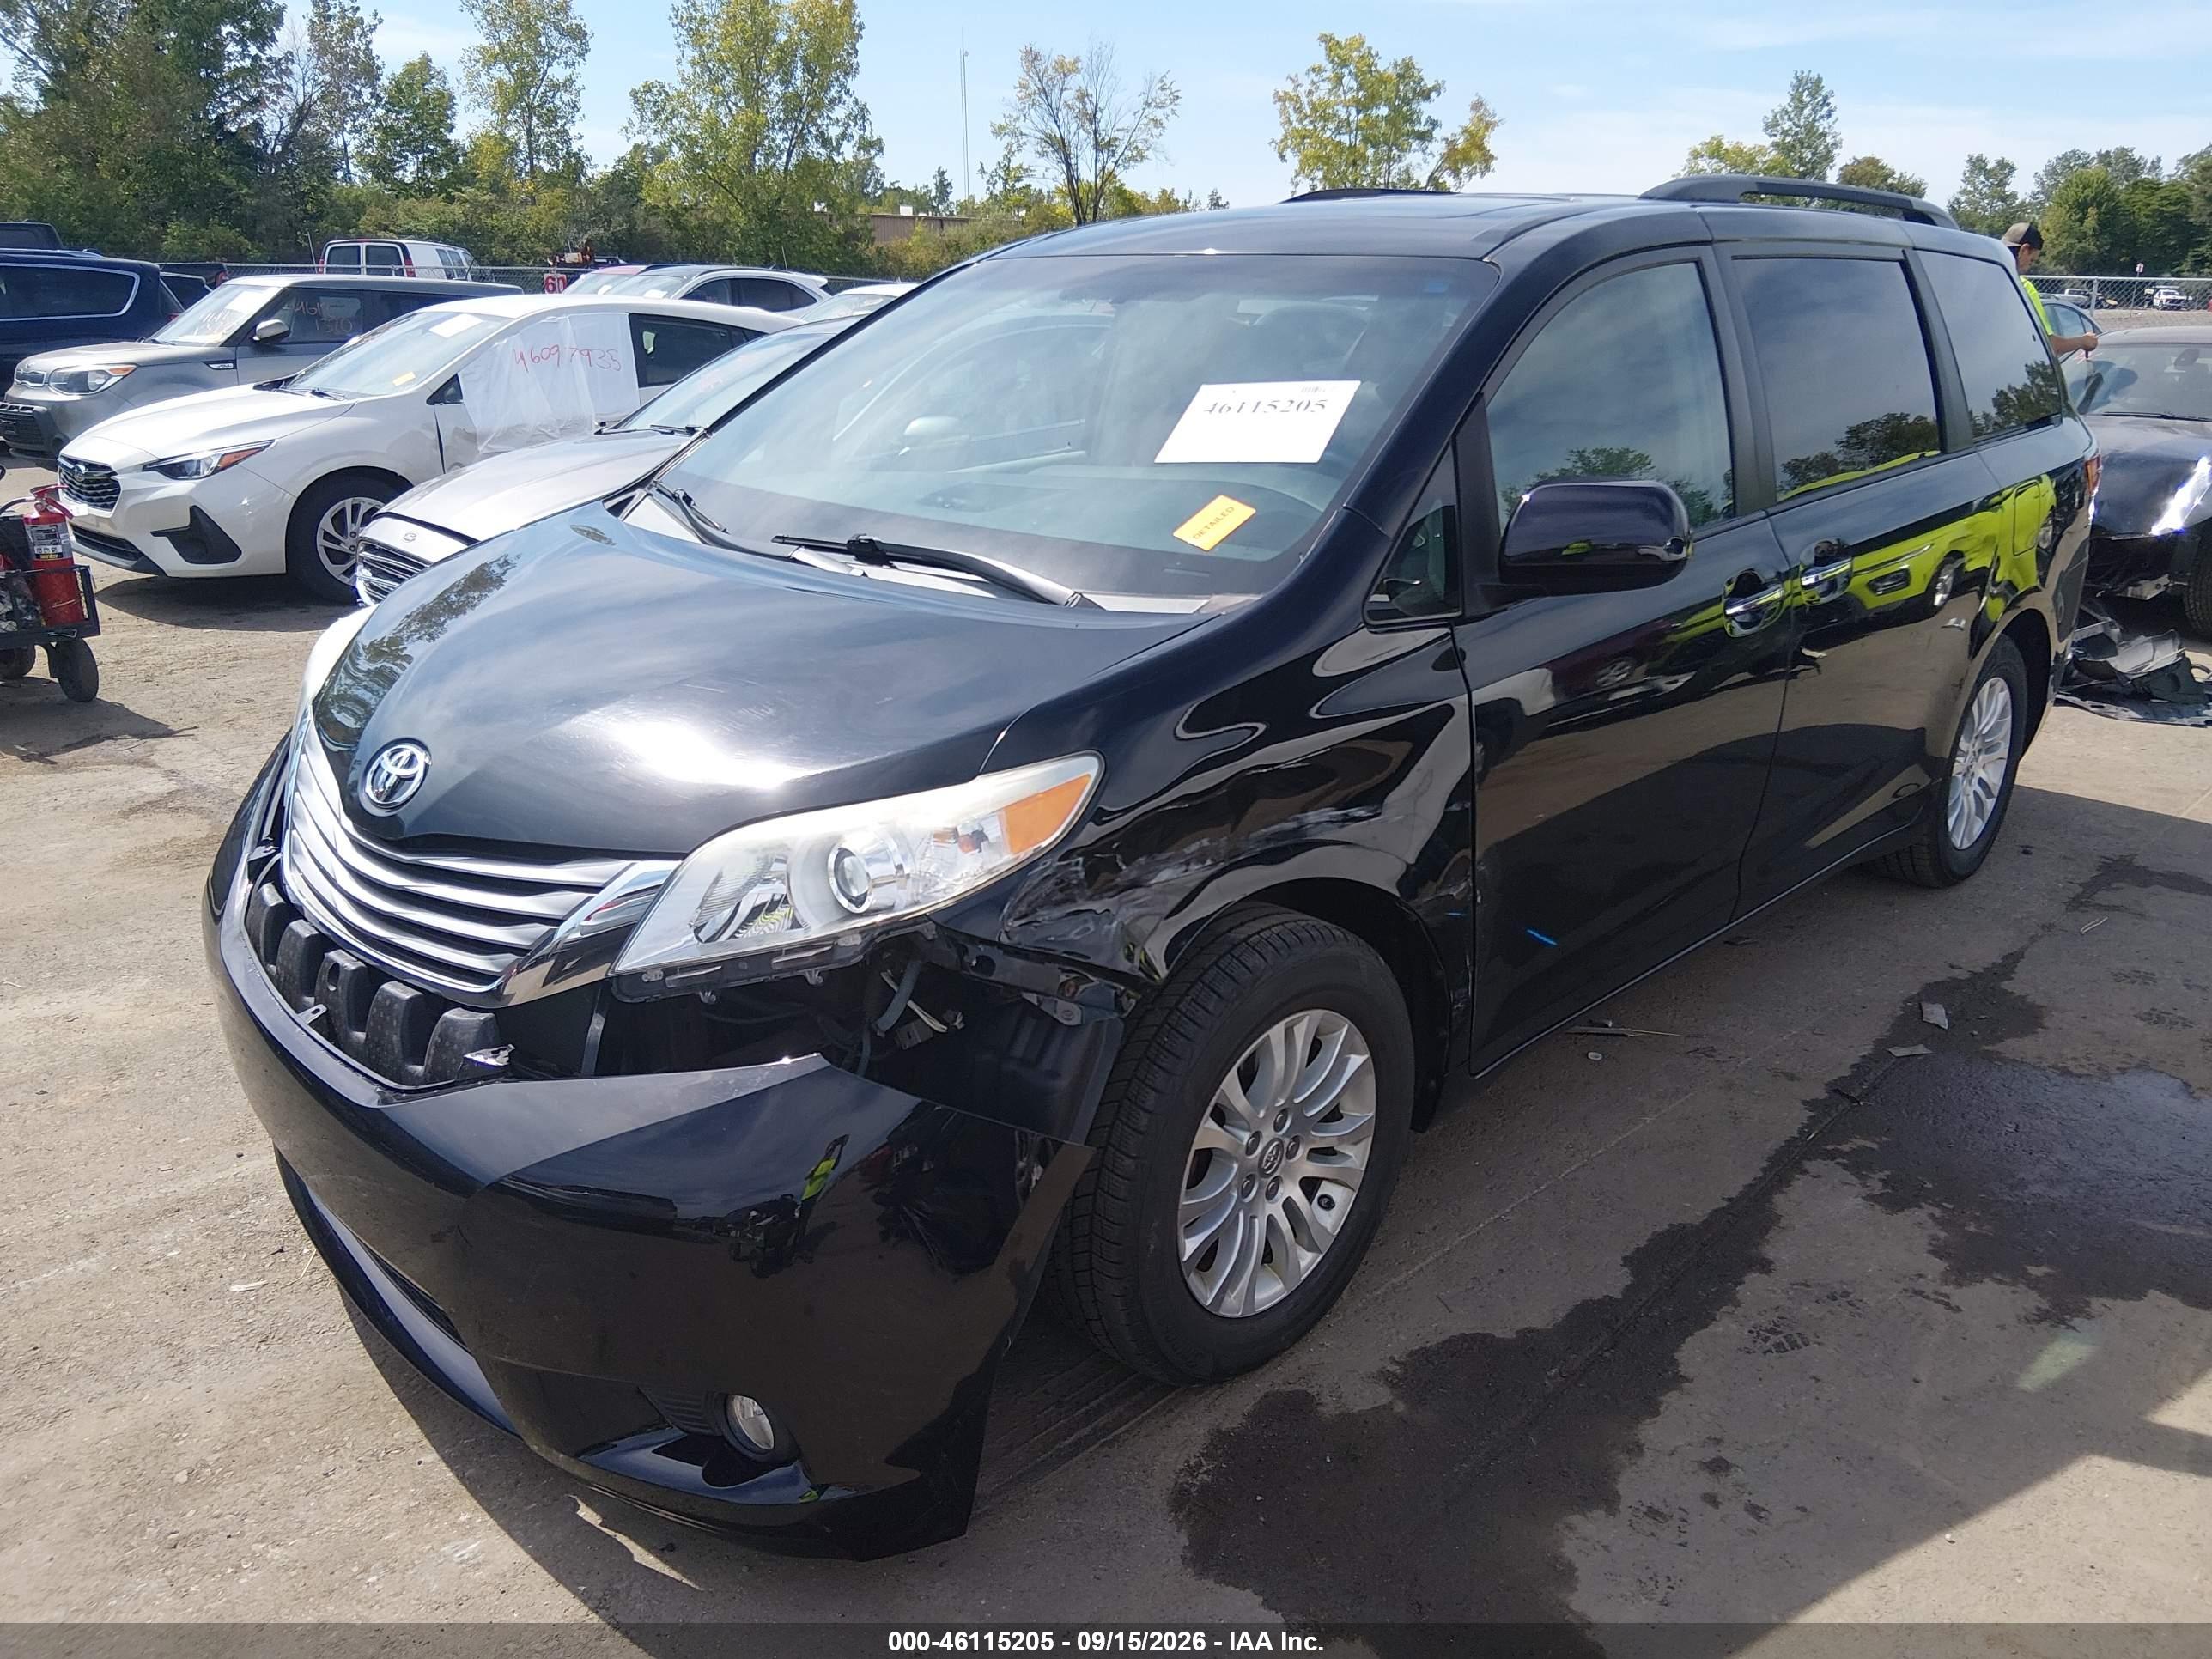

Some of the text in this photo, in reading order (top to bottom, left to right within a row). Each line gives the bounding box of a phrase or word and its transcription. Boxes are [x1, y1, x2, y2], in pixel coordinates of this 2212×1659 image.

[544, 276, 567, 294] 60
[1204, 398, 1328, 415] 46115205
[1192, 507, 1235, 540] DETAILED
